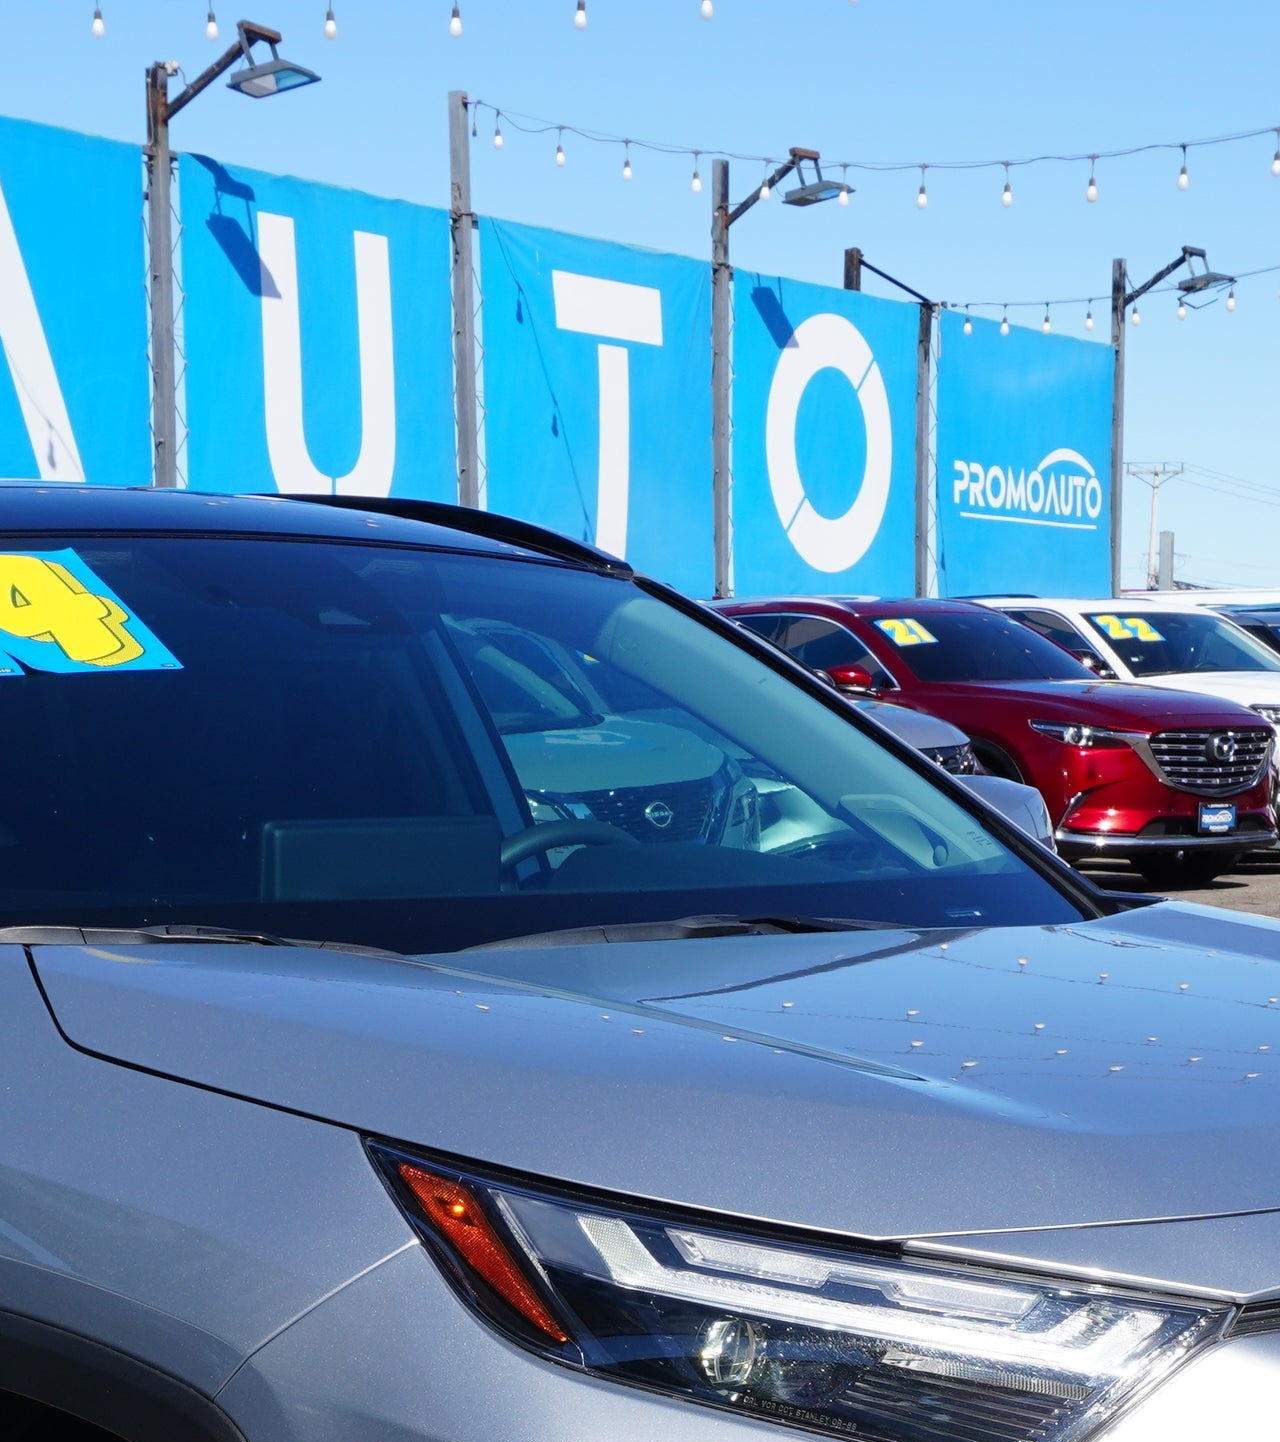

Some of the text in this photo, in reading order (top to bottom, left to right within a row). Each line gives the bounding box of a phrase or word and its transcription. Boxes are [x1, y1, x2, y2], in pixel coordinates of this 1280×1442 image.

[953, 459, 1102, 519] PROMOAUTO
[882, 619, 936, 645] 21
[1097, 615, 1162, 642] 22
[795, 1409, 830, 1424] STANLEY
